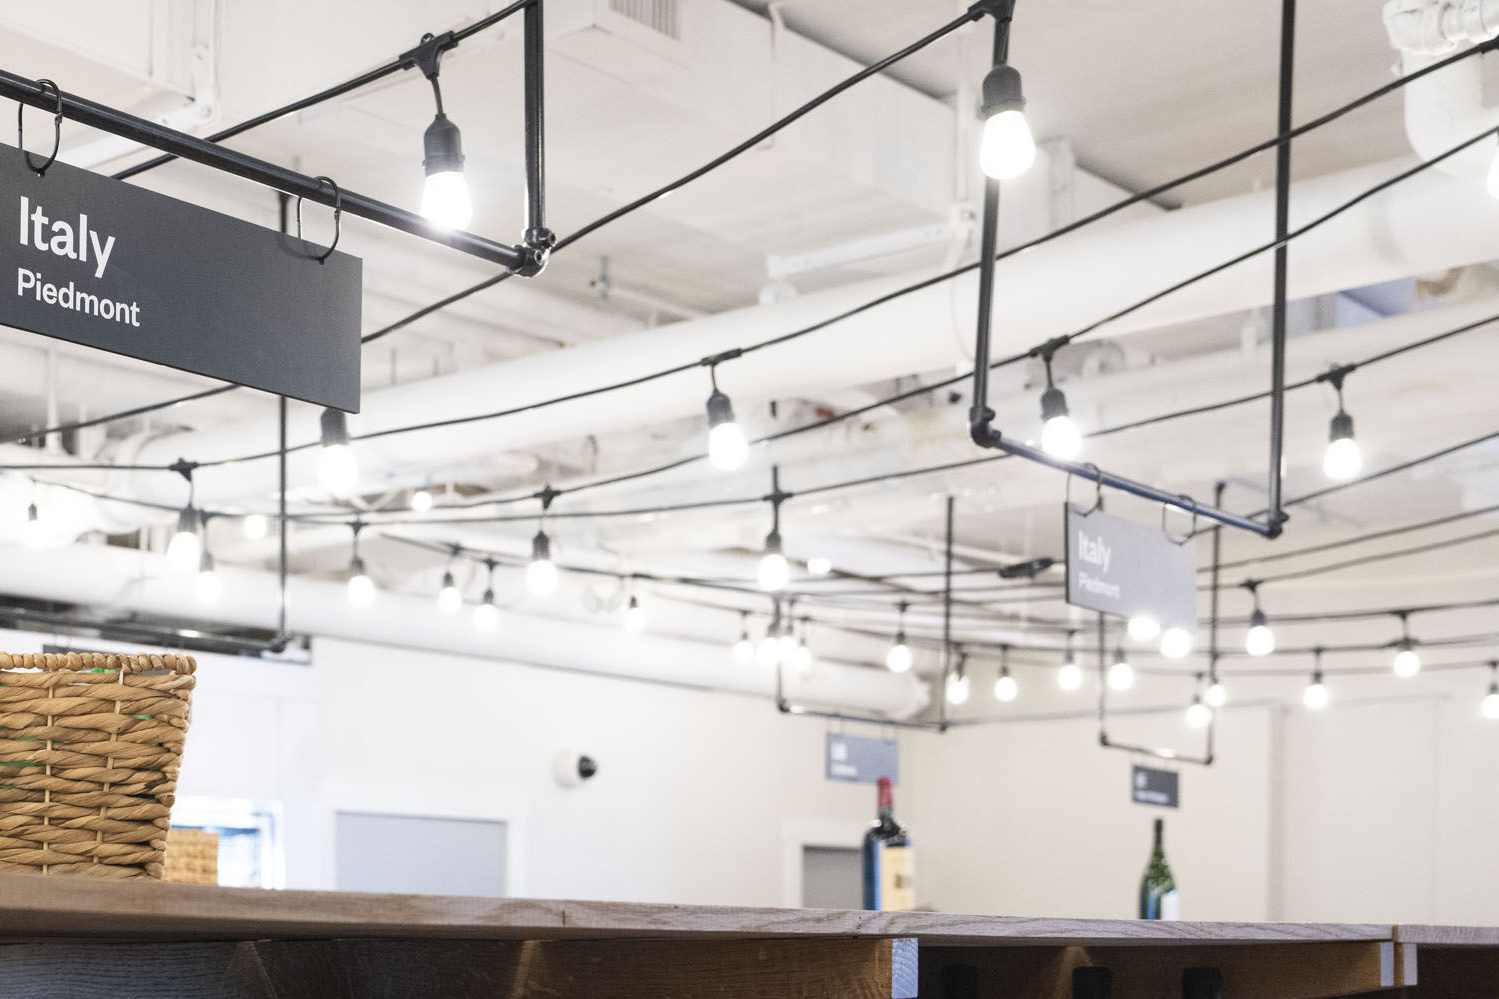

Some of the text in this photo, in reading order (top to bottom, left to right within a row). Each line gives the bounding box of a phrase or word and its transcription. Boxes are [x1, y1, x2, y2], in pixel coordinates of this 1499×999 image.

[19, 195, 116, 279] Italy
[17, 267, 140, 328] Piedmont
[1077, 529, 1112, 574] Italy
